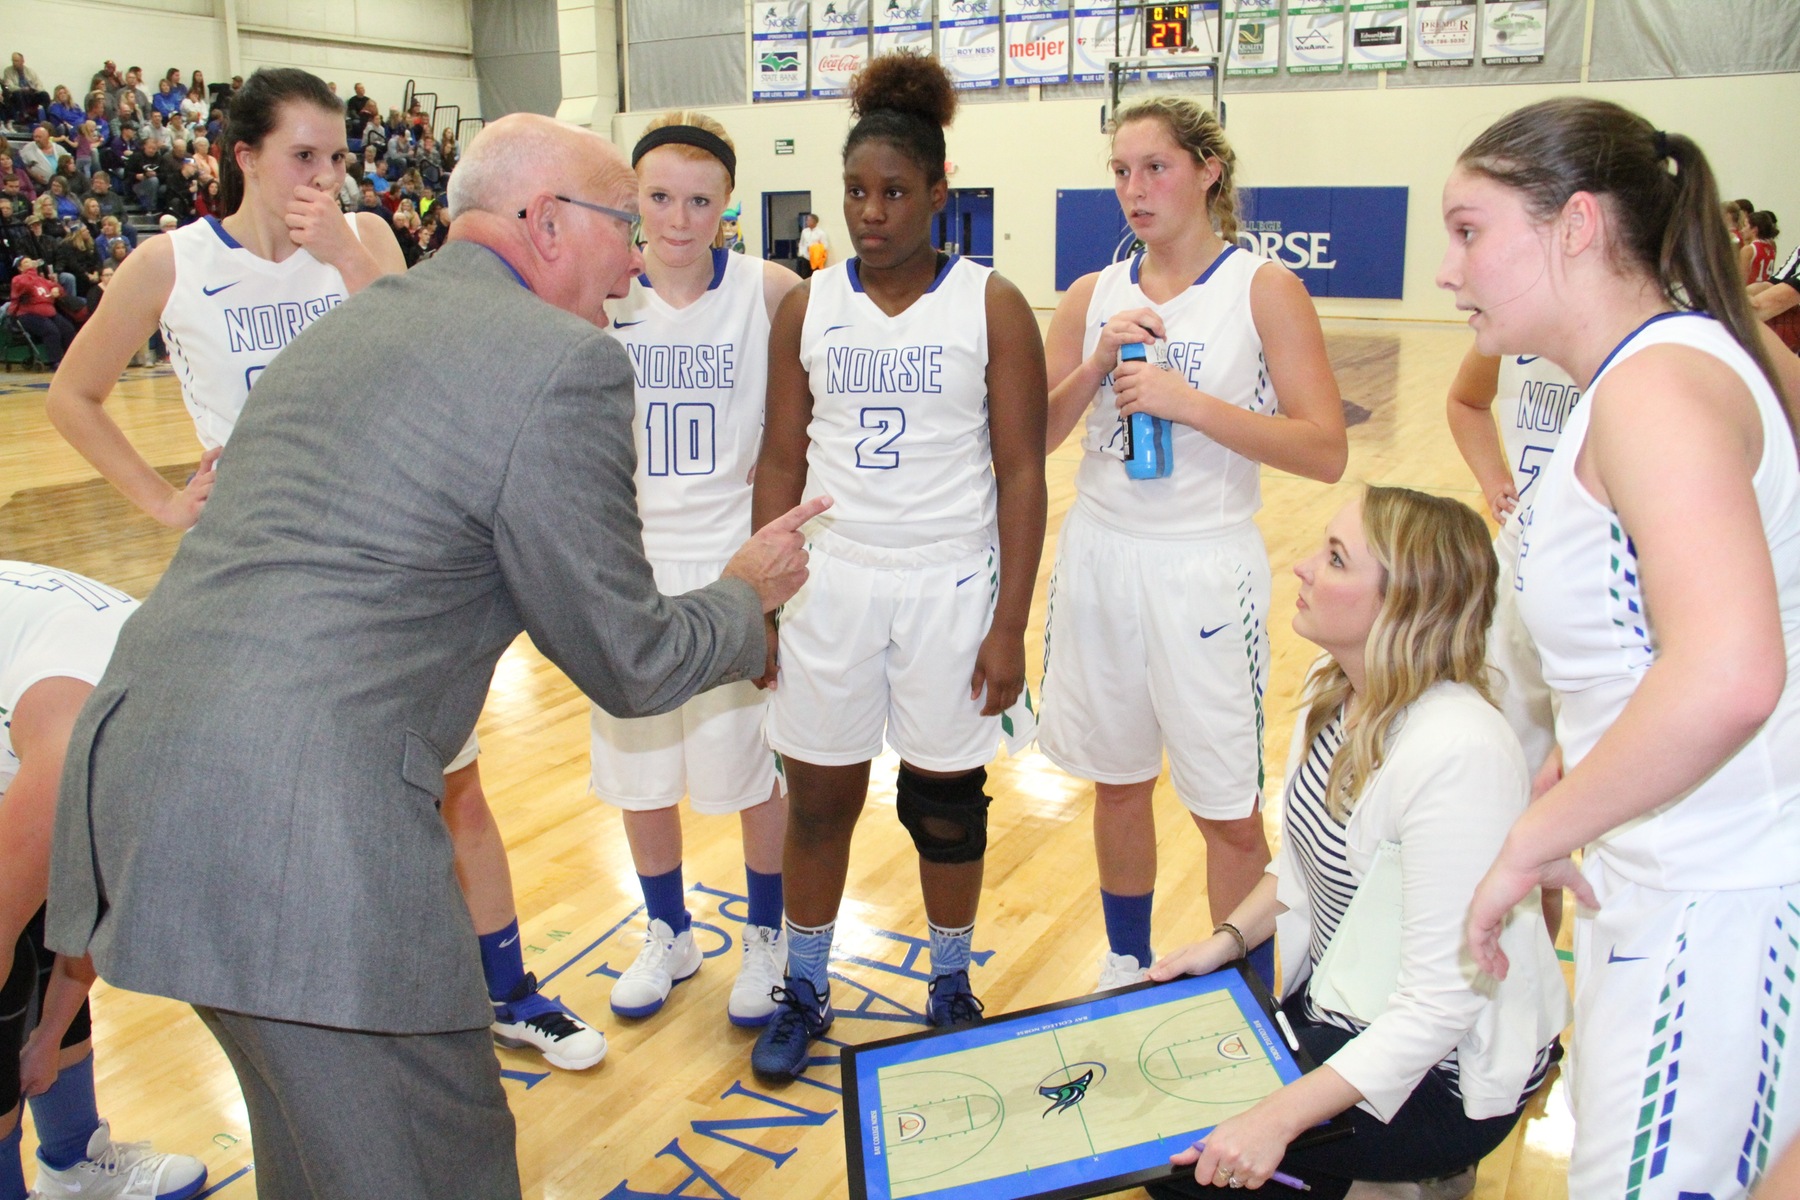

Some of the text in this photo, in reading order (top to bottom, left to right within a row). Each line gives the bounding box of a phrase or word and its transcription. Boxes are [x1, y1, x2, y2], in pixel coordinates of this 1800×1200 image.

[1151, 22, 1182, 48] 27
[975, 46, 996, 54] NESS
[1009, 36, 1065, 61] meijer
[627, 343, 734, 390] NORSE
[826, 345, 943, 394] NORSE
[646, 402, 716, 477] 10
[854, 407, 907, 470] 2
[1042, 1018, 1073, 1031] COLLEGE
[1074, 1015, 1089, 1024] BAY
